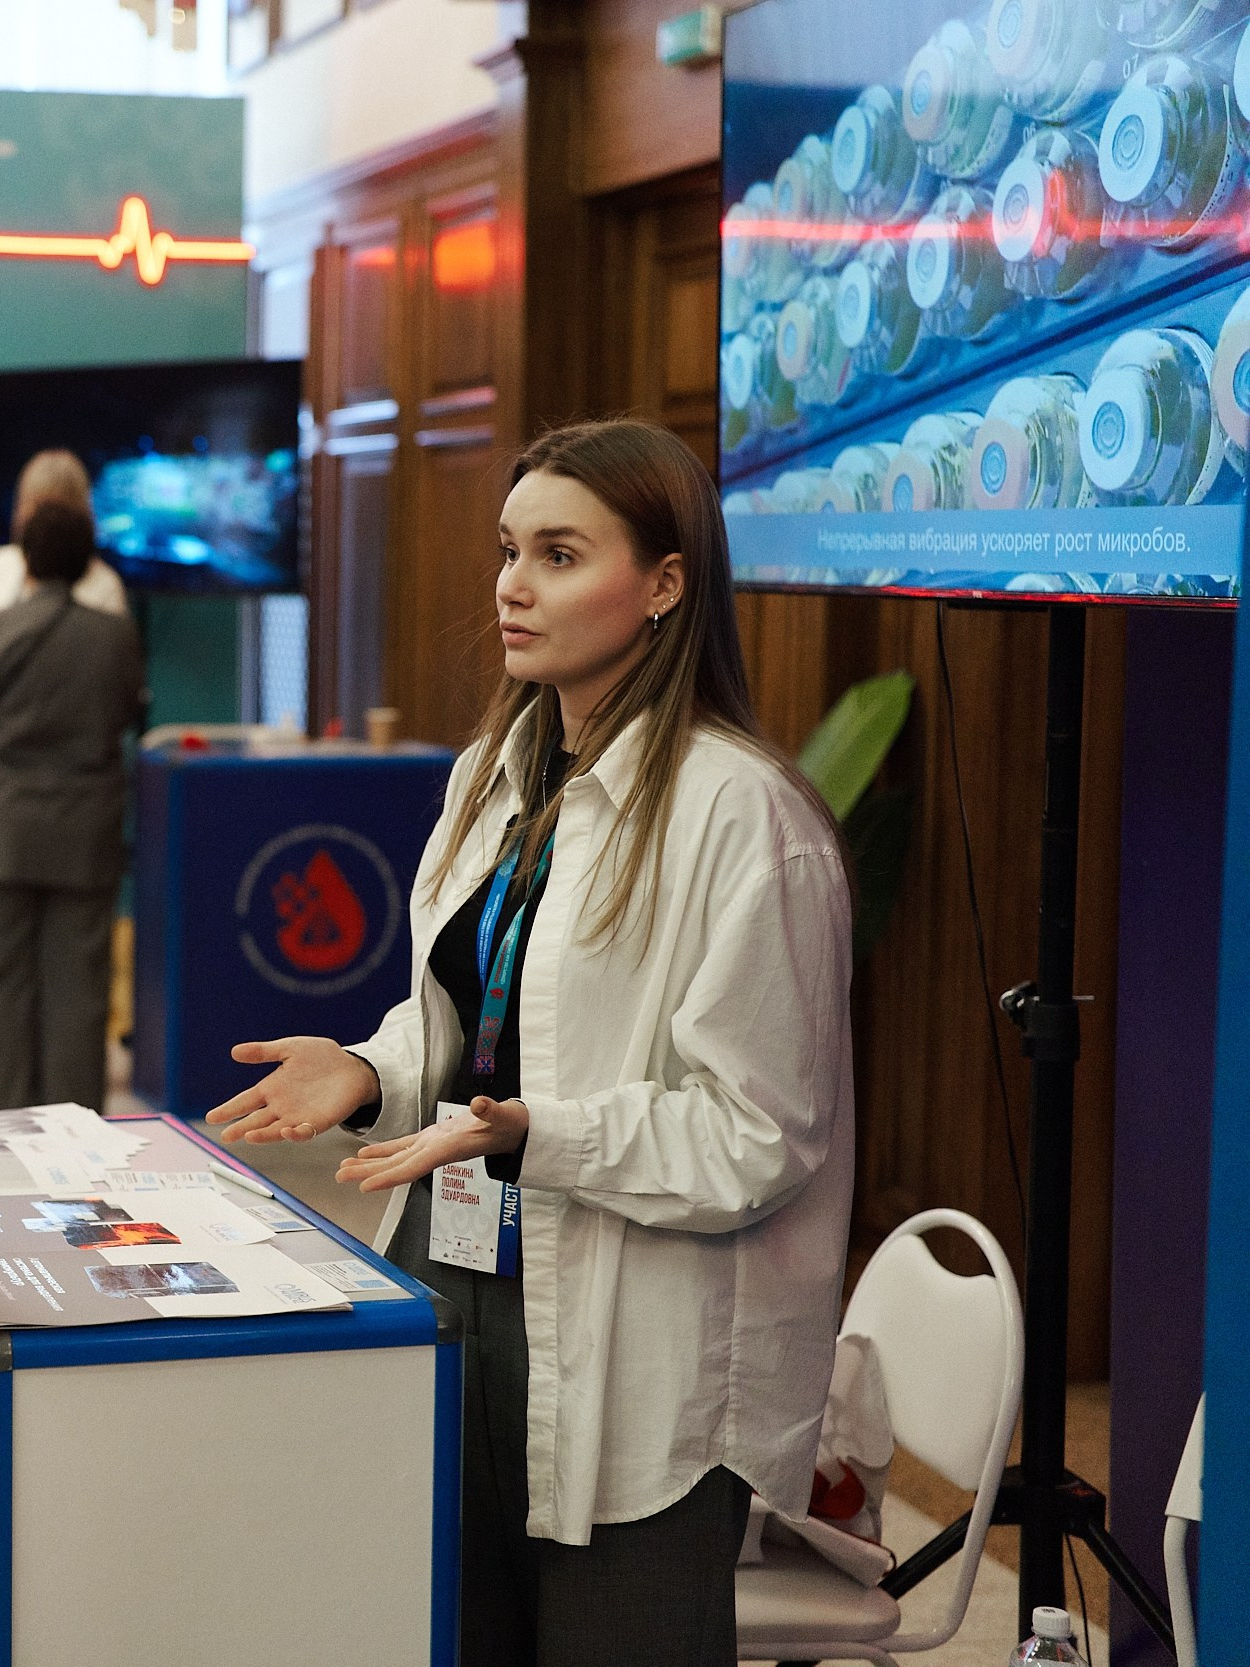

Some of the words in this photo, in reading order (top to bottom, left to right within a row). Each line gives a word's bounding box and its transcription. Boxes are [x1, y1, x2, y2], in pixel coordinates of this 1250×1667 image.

[1122, 53, 1140, 79] 07
[818, 529, 906, 554] Непрерывная
[909, 527, 978, 556] вибрация
[981, 531, 1049, 557] ускоряет
[1055, 531, 1092, 558] рост
[1098, 526, 1191, 558] микробов.
[441, 1177, 466, 1191] ПОЛИНА
[441, 1188, 480, 1206] ЭДУАРДОВНА
[502, 1182, 519, 1227] УЧАСТ
